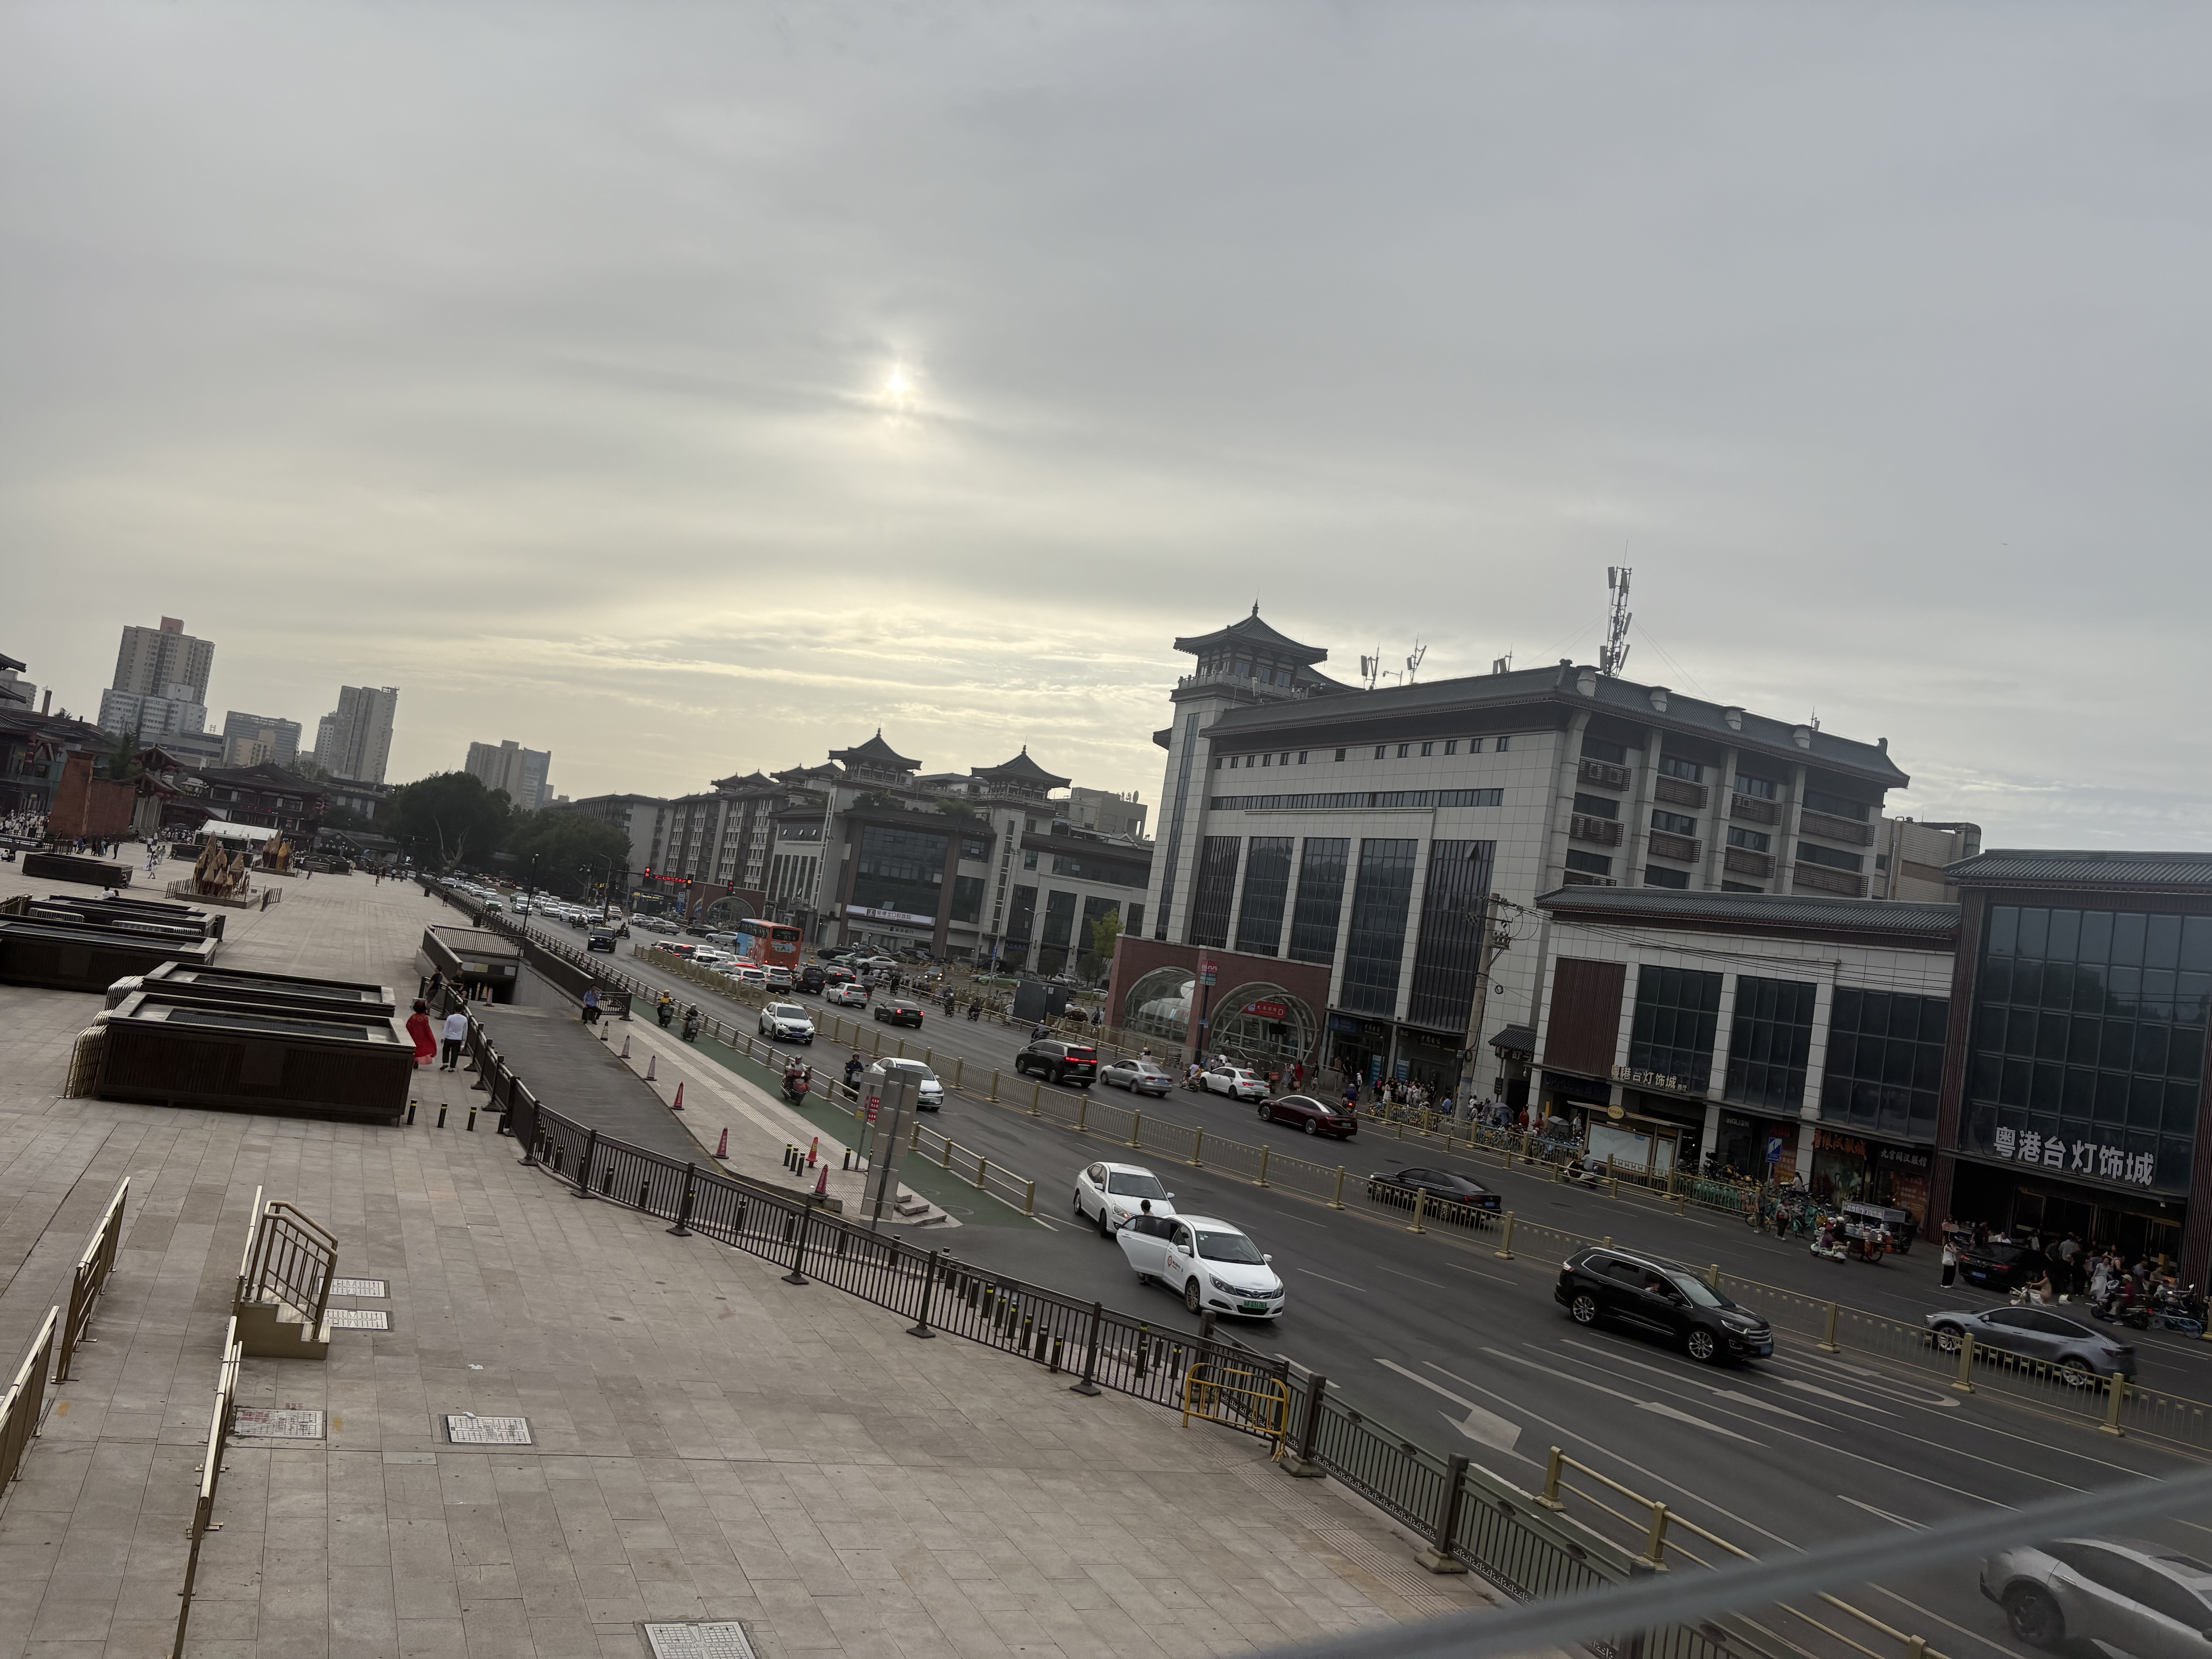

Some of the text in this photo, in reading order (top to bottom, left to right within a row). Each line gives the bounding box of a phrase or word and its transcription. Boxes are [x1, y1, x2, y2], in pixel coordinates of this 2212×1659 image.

[1611, 1065, 1677, 1089] 粤港台灯饰城
[1994, 1126, 2154, 1186] 粤港台灯饰城
